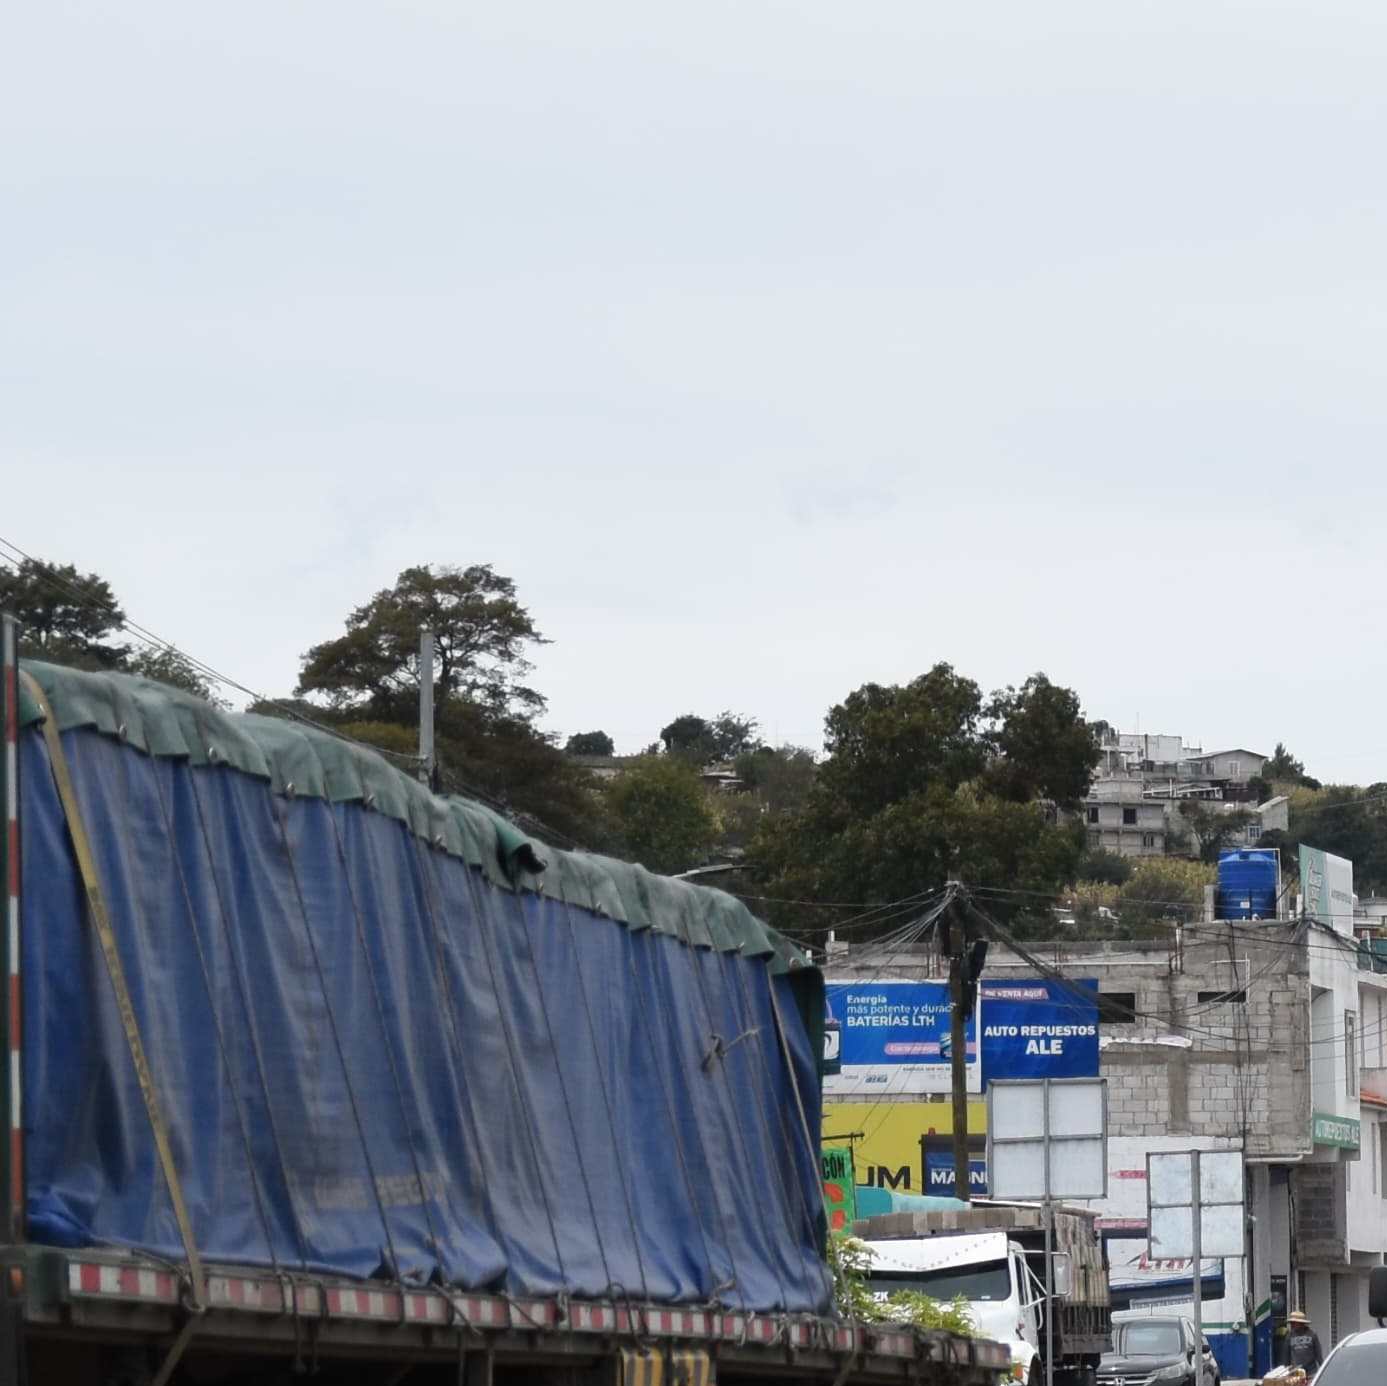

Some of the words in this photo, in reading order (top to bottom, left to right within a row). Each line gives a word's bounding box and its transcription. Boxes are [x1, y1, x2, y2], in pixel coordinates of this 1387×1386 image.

[847, 1014, 909, 1027] BATERÍAS
[912, 1016, 935, 1027] LTH
[984, 1026, 1018, 1037] AUTO
[1020, 1025, 1097, 1037] REPUESTOS
[1025, 1039, 1064, 1055] ALE
